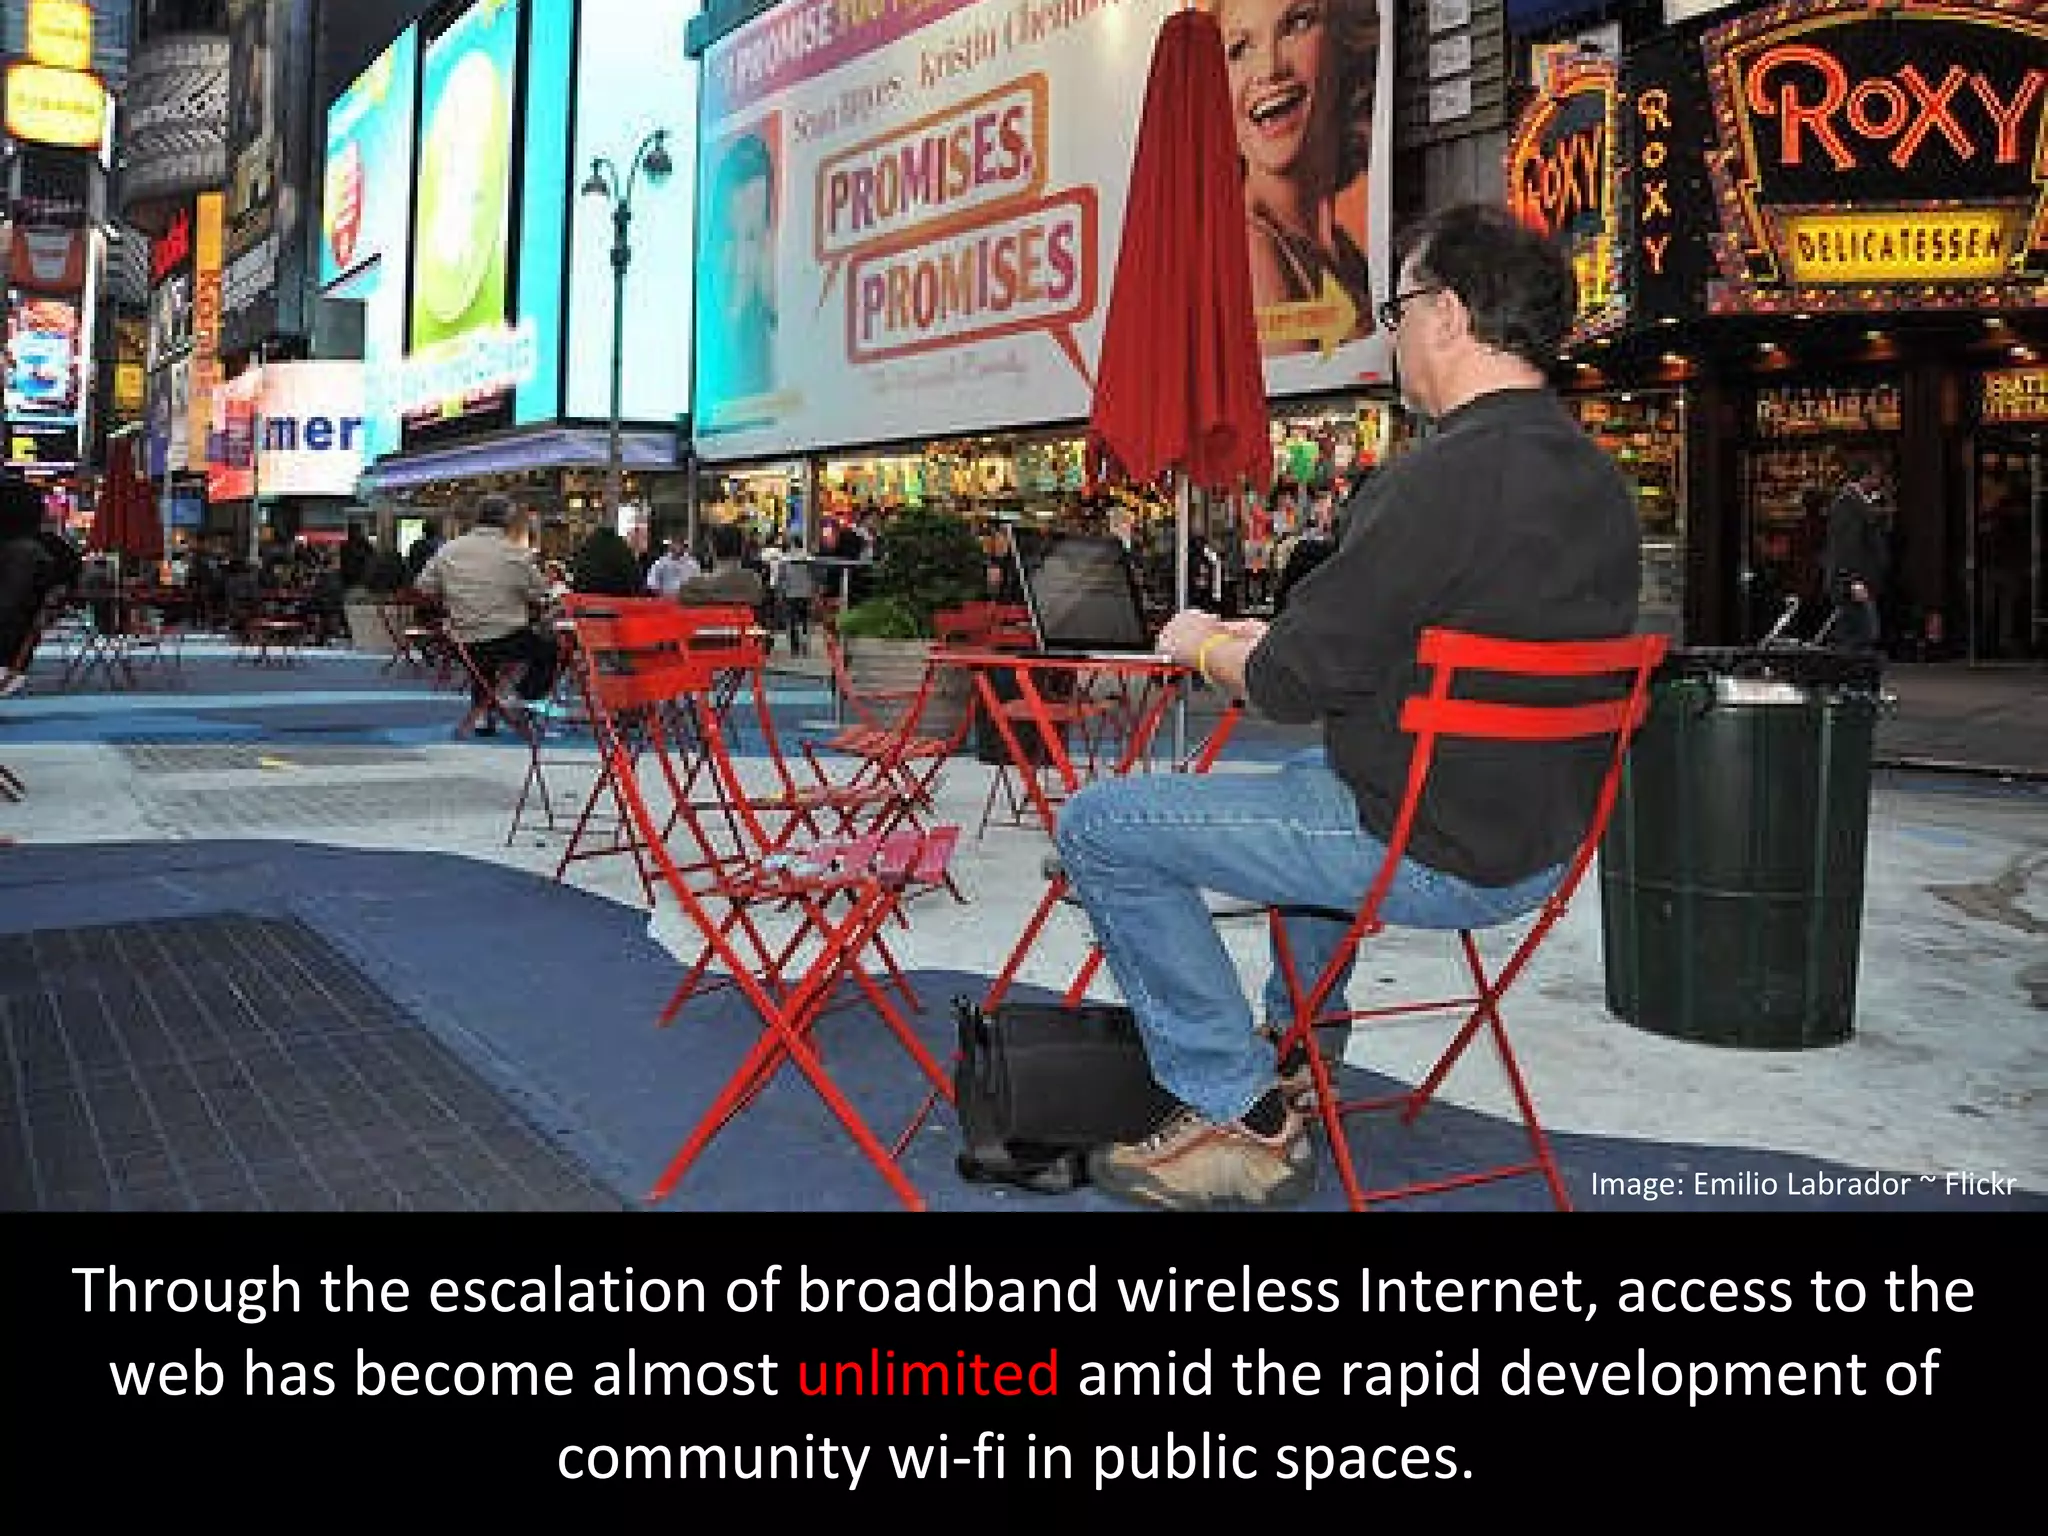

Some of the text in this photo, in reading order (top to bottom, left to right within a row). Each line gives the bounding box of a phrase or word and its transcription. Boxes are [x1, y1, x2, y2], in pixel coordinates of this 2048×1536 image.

[828, 104, 1032, 238] PROMISES,
[862, 219, 1076, 341] PROMISES
[1797, 226, 2001, 263] DELICATESSEN
